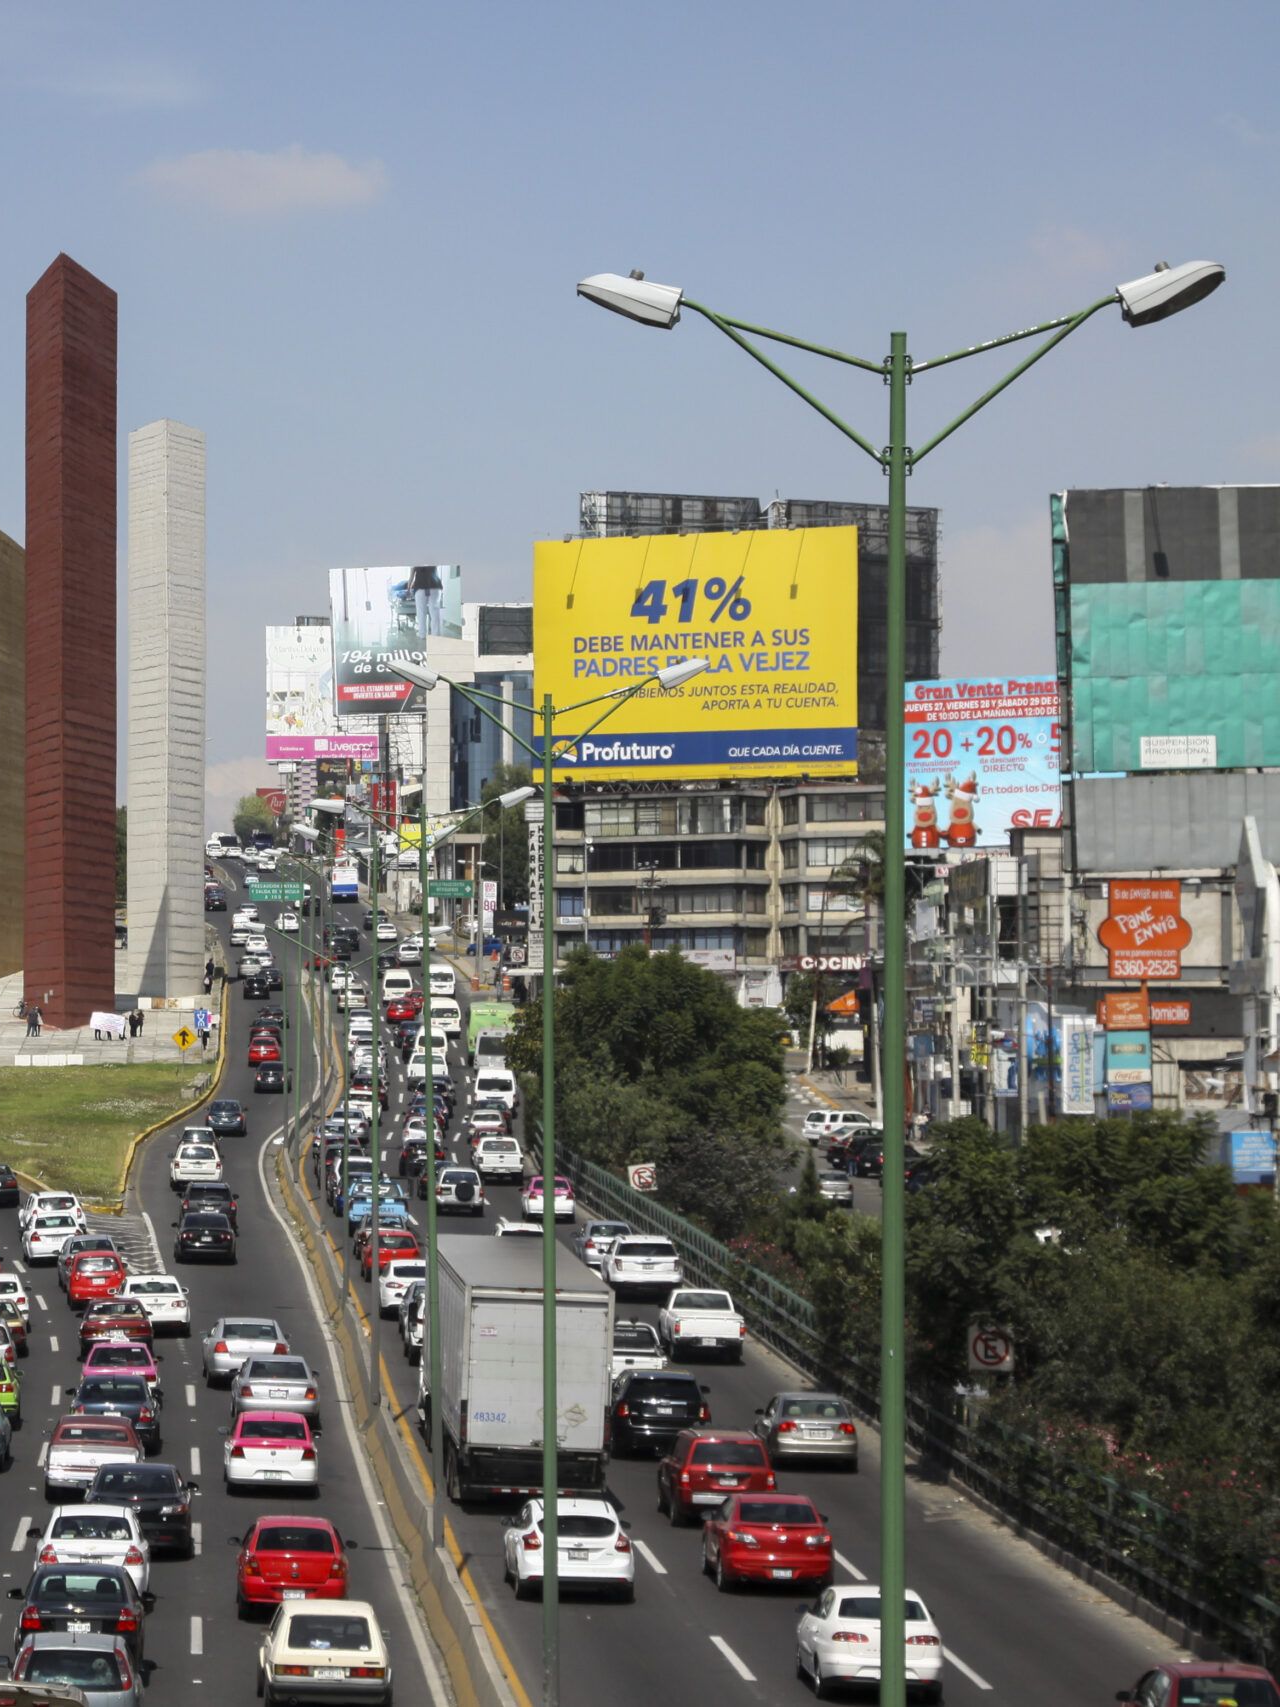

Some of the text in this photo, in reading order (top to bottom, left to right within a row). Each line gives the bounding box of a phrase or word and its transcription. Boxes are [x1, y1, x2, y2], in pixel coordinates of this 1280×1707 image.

[630, 576, 752, 624] 41%
[574, 628, 810, 653] DEBE MANTENER A SUS
[341, 650, 372, 663] 194
[354, 663, 372, 674] de
[574, 656, 659, 678] PADRES
[705, 654, 733, 673] LA
[738, 651, 810, 672] VEJEZ
[688, 685, 736, 697] JUNTOS
[741, 684, 770, 696] ESTA
[773, 682, 839, 695] REALIDAD,
[914, 684, 953, 700] Gran
[956, 682, 1004, 697] Venta
[702, 696, 839, 710] APORTA A TU CUENTA.
[904, 704, 932, 712] JUEVES
[934, 702, 946, 712] 27,
[947, 700, 980, 710] VIERNES
[980, 700, 990, 708] 28
[992, 700, 996, 708] Y
[998, 698, 1028, 708] SÁBADO
[1030, 697, 1040, 706] 29
[1042, 696, 1052, 705] DE
[927, 706, 1058, 721] DE 10:00 DE LA MAÑANA A 12:00 DE
[329, 740, 374, 754] Liverpool
[912, 728, 952, 759] 20
[977, 725, 1032, 756] 20%
[582, 742, 672, 762] Profuturo
[728, 744, 844, 758] QUE CADA DÍA CUENTE.
[906, 760, 960, 768] mensualidades
[983, 763, 1025, 772] DIRECTO
[981, 786, 993, 794] En
[996, 784, 1024, 794] todos
[1025, 784, 1040, 792] los
[1114, 960, 1178, 976] 5360-2525
[1068, 1032, 1080, 1102] San Pablo
[474, 1412, 507, 1424] 483342
